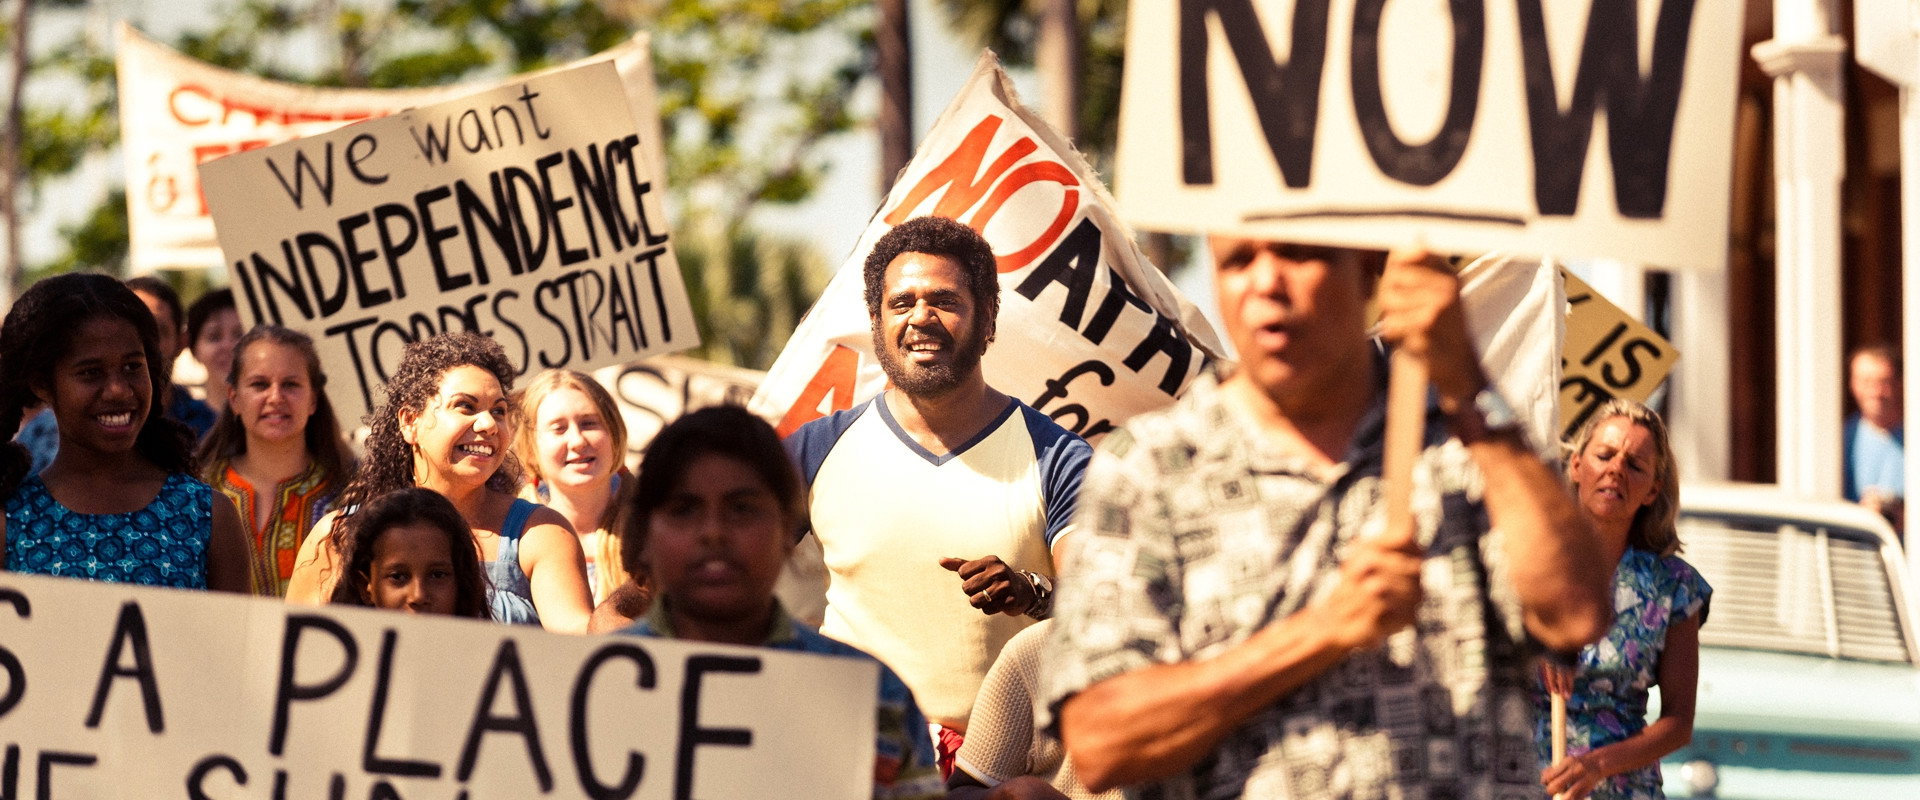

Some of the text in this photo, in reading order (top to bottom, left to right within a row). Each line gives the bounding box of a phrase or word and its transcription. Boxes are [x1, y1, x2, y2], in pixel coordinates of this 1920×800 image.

[266, 133, 390, 210] We
[409, 85, 551, 163] want
[1178, 0, 1693, 219] NOW
[235, 134, 668, 326] INDEPENDENCE
[884, 113, 1081, 274] NO
[534, 247, 672, 369] STRAIT
[1582, 321, 1662, 389] IS
[85, 601, 165, 734] A
